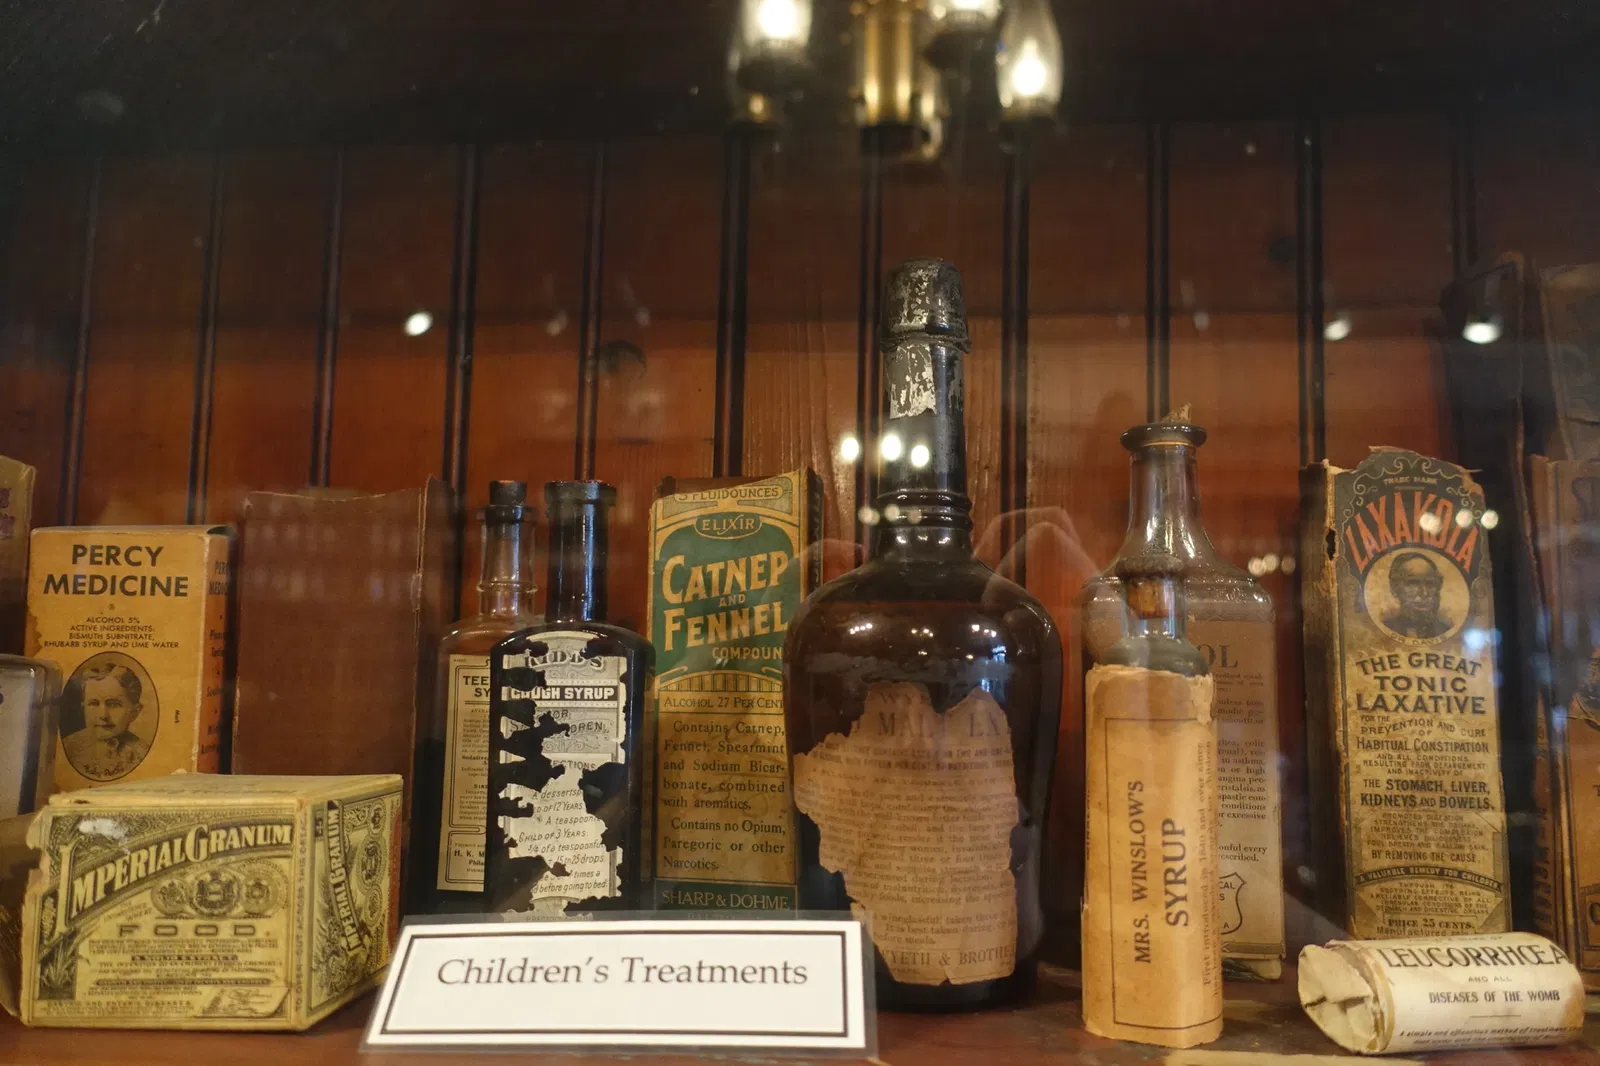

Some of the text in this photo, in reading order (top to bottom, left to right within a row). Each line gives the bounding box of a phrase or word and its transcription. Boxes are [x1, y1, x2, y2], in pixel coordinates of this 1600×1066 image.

[702, 514, 755, 536] ELIXIR
[1345, 491, 1480, 575] LAXAKOLA
[71, 544, 164, 567] PERCY
[661, 550, 790, 605] CATNEP
[43, 574, 189, 598] MEDICINE
[718, 593, 746, 608] AND
[86, 616, 140, 624] ALCOHOL 5%
[664, 601, 790, 652] FENNEL
[69, 632, 103, 640] BISMUTH
[44, 640, 80, 648] RHUBARB
[82, 640, 108, 648] SYRUP
[110, 640, 129, 648] AND
[131, 640, 149, 648] LIME
[712, 646, 783, 660] COMPOUN
[1356, 652, 1482, 677] THE GREAT
[1373, 675, 1468, 694] TONIC
[564, 687, 615, 700] SYRUP
[663, 697, 714, 708] ALCOHOL
[717, 697, 729, 708] 27
[733, 697, 754, 709] PER
[1356, 692, 1487, 715] LAXATIVE
[1361, 714, 1390, 723] FOR THE
[673, 720, 785, 736] Contains Catnep,
[1360, 718, 1486, 738] PREVENTION AND CURE
[664, 740, 784, 755] Fennel, Spearmint
[1356, 736, 1489, 753] HABITUAL CONSTIPATION
[663, 759, 785, 773] and Sodium Bicar-
[1362, 760, 1407, 768] RESULTING
[663, 778, 785, 793] bonate, combined
[1363, 778, 1491, 795] THE STOMACH, LIVER,
[531, 791, 539, 800] A
[663, 796, 752, 810] with aromatics.
[1360, 792, 1496, 810] KIDNEYS AND BOWELS.
[544, 817, 552, 825] A
[671, 817, 786, 835] Contains no Opium,
[518, 828, 589, 843] CHILD OF 3 YEARS:
[327, 808, 347, 884] GRANUM
[558, 840, 605, 852] teaspoonfu
[663, 836, 786, 853] Paregoric or other
[1243, 845, 1268, 855] every
[580, 853, 605, 866] drops
[663, 856, 720, 871] Narcotics.
[1371, 850, 1381, 859] BY
[1385, 850, 1428, 860] REMOVING
[1430, 852, 1445, 862] THE
[56, 823, 293, 935] IMPERIAL GRANUM
[1127, 779, 1152, 964] MRS. WINSLOW'S
[1161, 817, 1189, 927] SYRUP
[1367, 867, 1406, 881] VALUABLE
[539, 884, 565, 893] before
[563, 883, 585, 894] going
[661, 890, 790, 910] SHARP & DOHME
[1200, 884, 1210, 951] introduced
[1387, 917, 1476, 930] PRICE 25 CENTS.
[938, 949, 952, 967] &
[437, 956, 809, 986] Children's Treatments
[1202, 954, 1212, 985] First
[1429, 990, 1561, 1004] DISEASES OF THE WOMB
